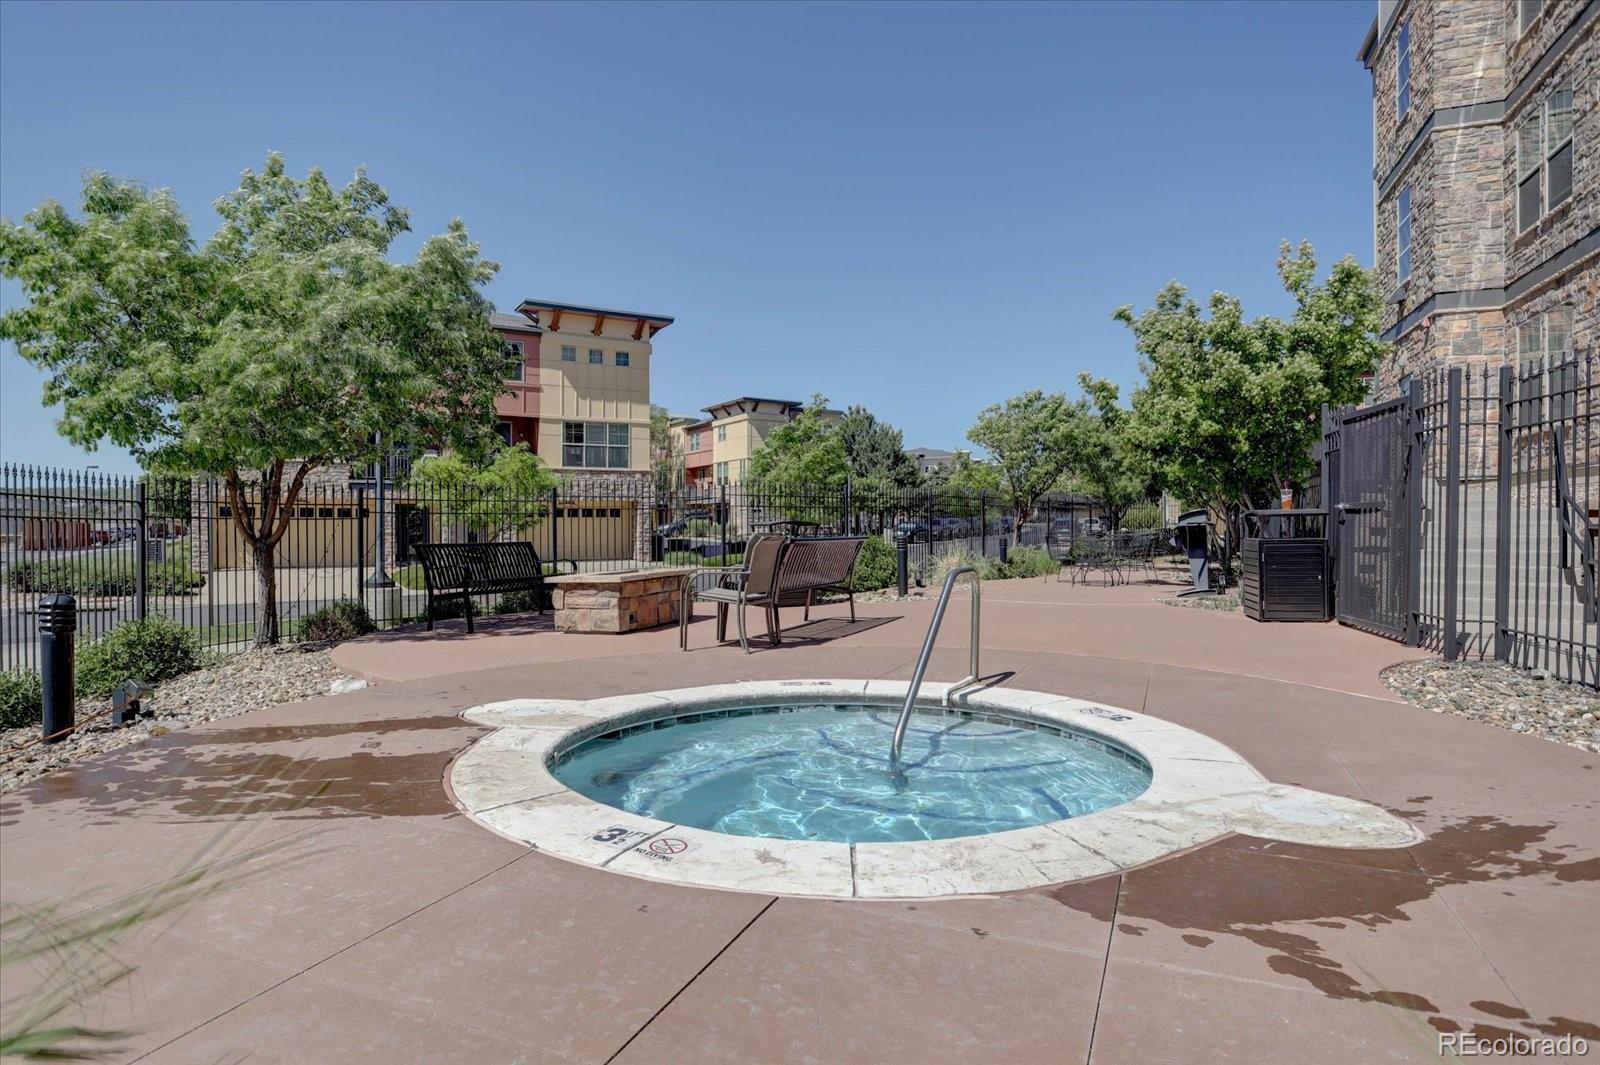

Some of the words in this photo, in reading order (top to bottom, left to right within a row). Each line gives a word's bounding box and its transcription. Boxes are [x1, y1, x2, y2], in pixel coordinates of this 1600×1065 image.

[593, 827, 628, 842] 3
[633, 847, 647, 855] NO
[645, 850, 673, 861] DIVING
